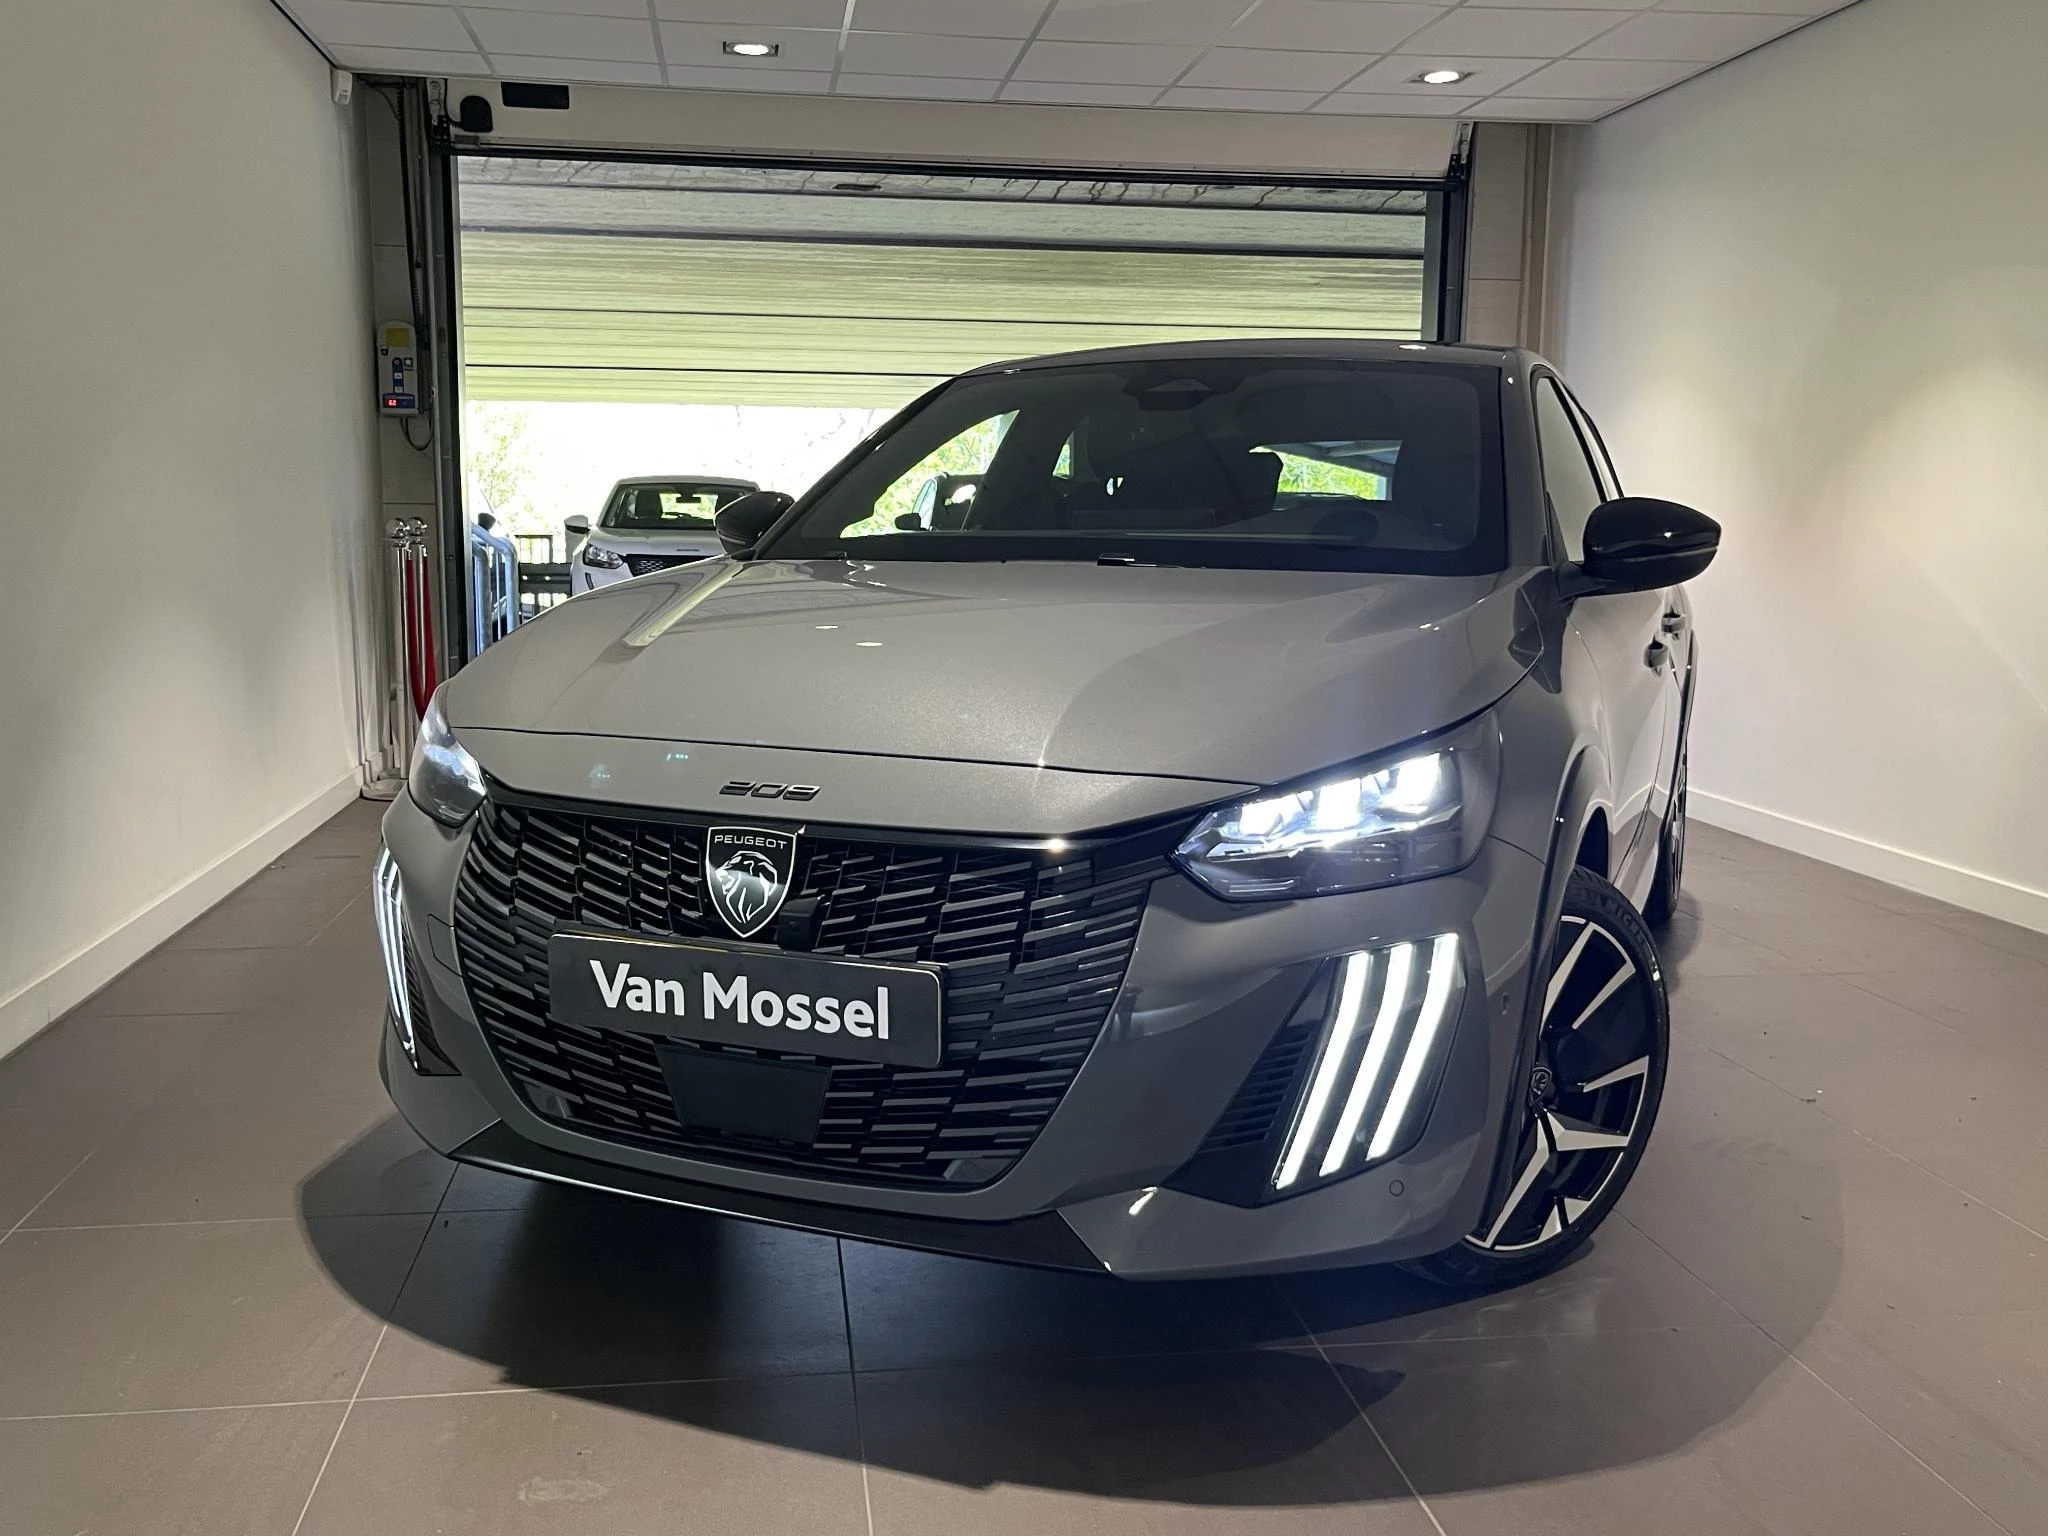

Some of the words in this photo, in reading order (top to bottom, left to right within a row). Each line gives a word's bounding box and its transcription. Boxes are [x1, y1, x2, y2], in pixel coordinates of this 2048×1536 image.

[719, 781, 821, 802] 208
[714, 834, 787, 850] PEUGEOT
[589, 959, 685, 1017] Van
[702, 971, 889, 1040] Mossel
